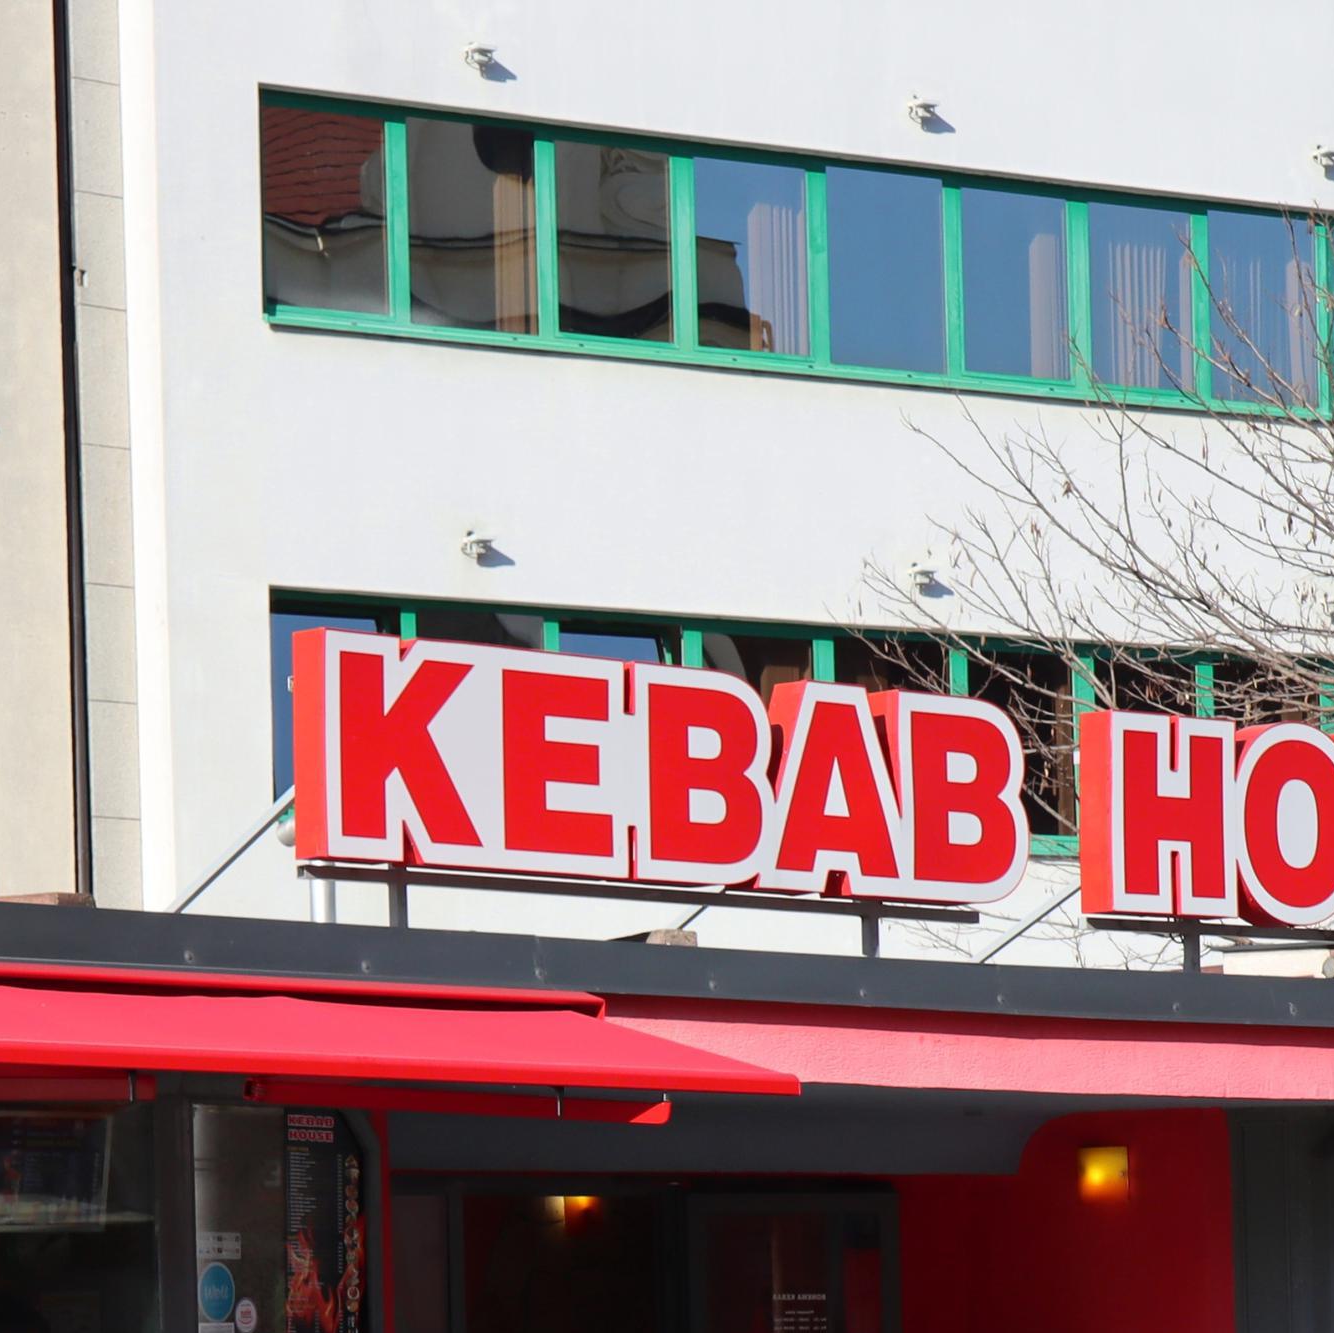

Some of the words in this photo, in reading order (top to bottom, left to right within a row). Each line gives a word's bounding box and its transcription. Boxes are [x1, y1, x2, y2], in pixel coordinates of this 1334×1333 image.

[315, 630, 1027, 905] KEBAB
[286, 1114, 335, 1129] KEBAB
[287, 1130, 334, 1143] HOUSE
